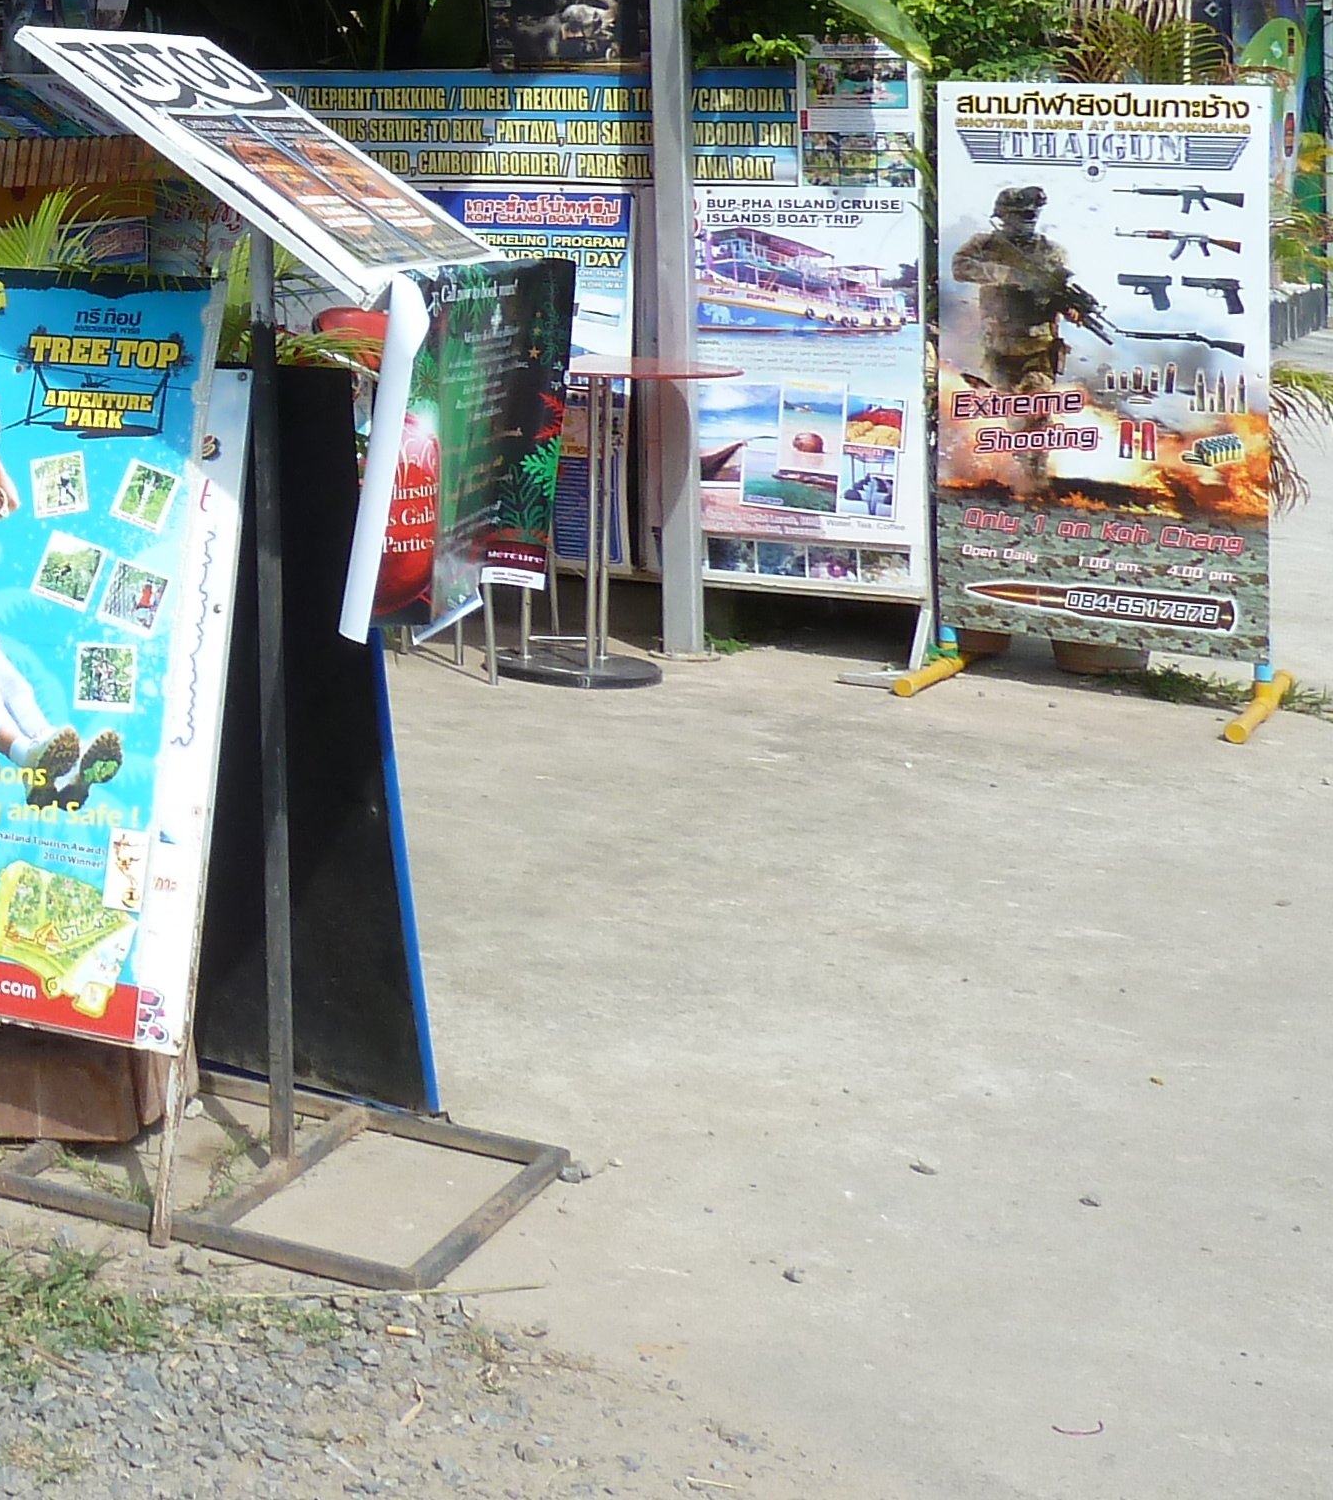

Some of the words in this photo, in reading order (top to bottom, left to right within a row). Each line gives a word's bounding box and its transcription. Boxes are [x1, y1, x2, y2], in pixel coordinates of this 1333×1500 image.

[308, 88, 372, 109] ELEPHENT
[374, 88, 445, 109] TREKKING
[459, 88, 511, 110] JUNGEL
[515, 88, 589, 111] TREKKING
[603, 88, 630, 111] AIR
[956, 91, 1250, 120] สนามกีฬายิงปืนเกาะช้าง
[369, 120, 427, 141] SERVICE
[433, 120, 449, 141] TO
[566, 121, 598, 144] KOH
[956, 118, 1028, 130] SHOOTING
[1034, 118, 1084, 131] RANGE
[1089, 120, 1109, 131] AT
[1001, 131, 1186, 163] THAIGUN
[417, 151, 495, 174] CAMBODIA
[499, 152, 559, 175] BORDER
[733, 157, 775, 180] BOAT
[707, 199, 773, 210] BUP-PHA
[778, 199, 835, 210] ISLAND
[841, 199, 900, 210] CRUISE
[466, 213, 492, 223] KOH
[498, 214, 541, 223] CHANG
[548, 215, 582, 224] BOAT
[590, 215, 618, 225] TRIP
[706, 213, 771, 224] ISLANDS
[777, 214, 818, 225] BOAT
[825, 214, 860, 225] TRIP
[552, 237, 626, 248] PROGRAM
[585, 253, 624, 268] DAY
[30, 335, 112, 365] TREE
[116, 340, 179, 369] TOP
[43, 389, 153, 411] ADVENTURE
[952, 390, 1084, 421] Extreme
[65, 408, 124, 429] PARK
[975, 426, 1099, 454] Shooting
[402, 505, 434, 526] Gala
[877, 523, 906, 532] Coffee
[963, 507, 1020, 534] Only
[1032, 514, 1045, 534] 1
[1058, 522, 1091, 539] on
[1101, 522, 1151, 545] Koh
[1159, 526, 1245, 556] Chang
[487, 550, 545, 564] Mercure
[962, 544, 998, 559] Open
[1003, 548, 1038, 564] Daily
[1078, 555, 1110, 570] 1.00
[1167, 564, 1203, 580] 4.00
[1066, 590, 1219, 624] 084-6517878
[7, 800, 58, 823] and
[66, 801, 123, 826] Safe
[34, 836, 70, 849] Tourism
[44, 852, 67, 862] 2010
